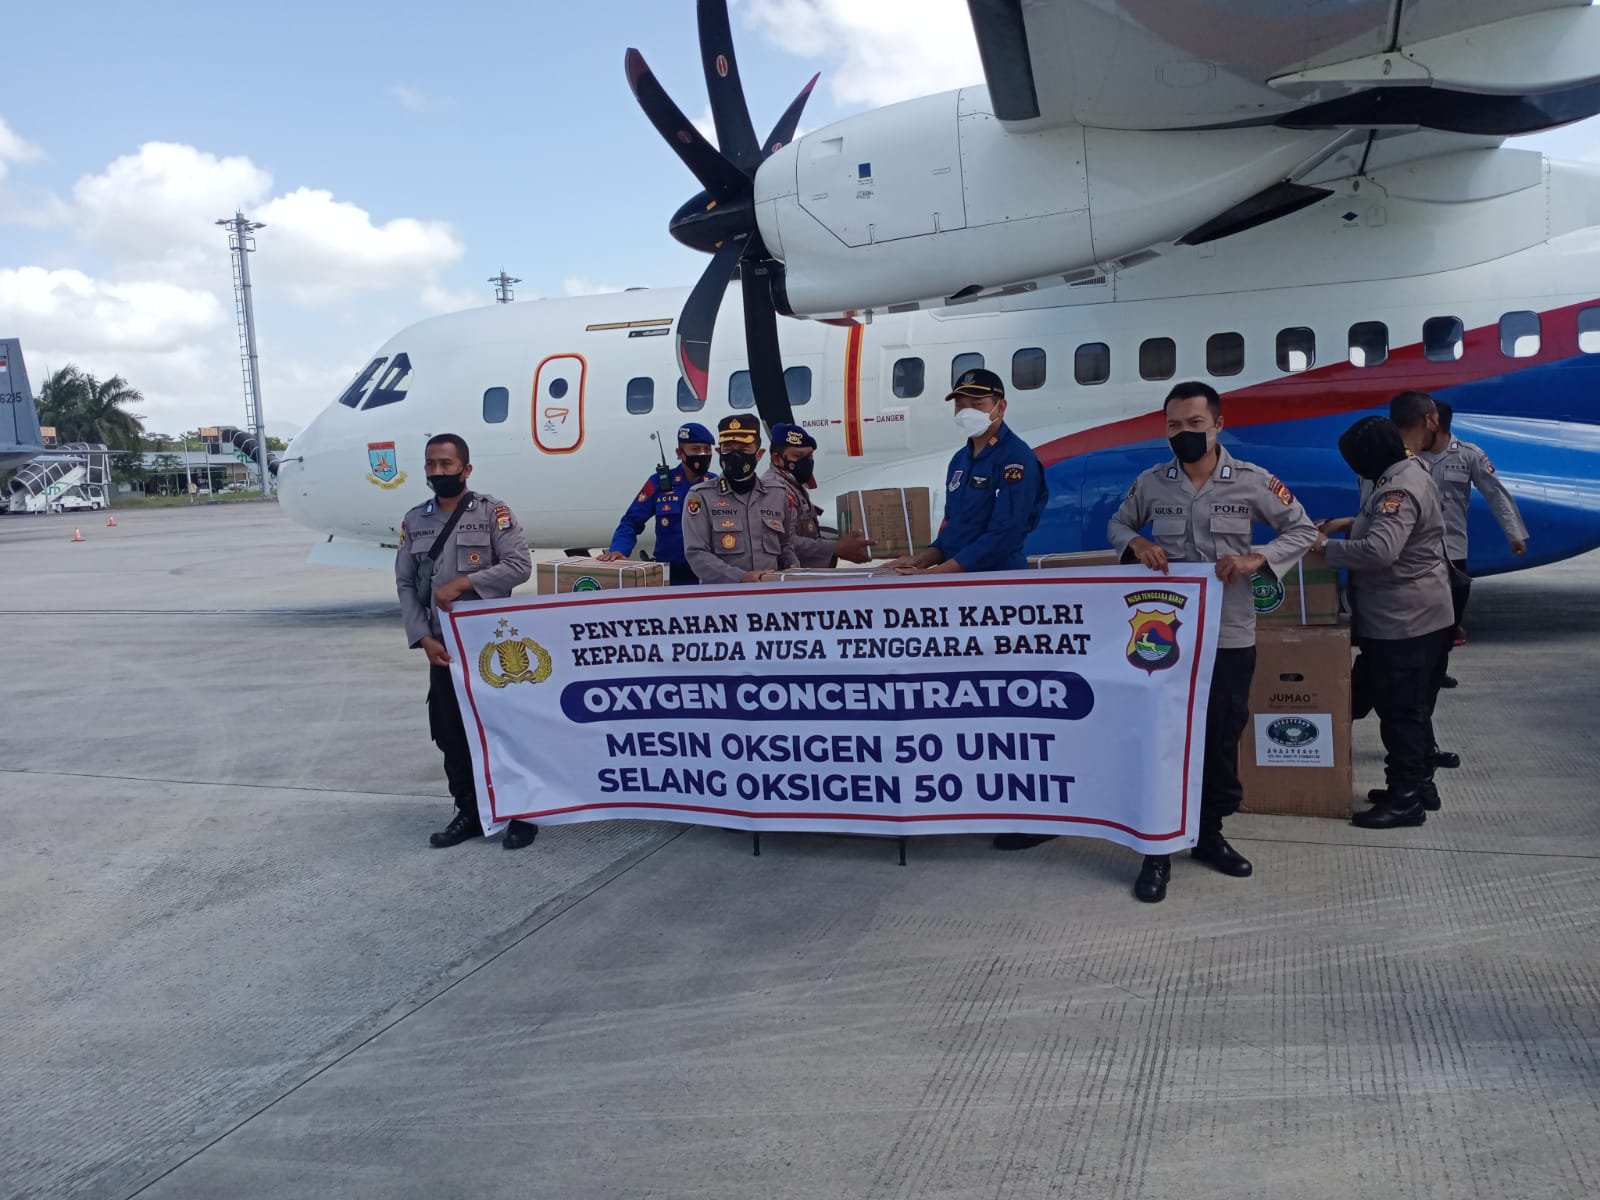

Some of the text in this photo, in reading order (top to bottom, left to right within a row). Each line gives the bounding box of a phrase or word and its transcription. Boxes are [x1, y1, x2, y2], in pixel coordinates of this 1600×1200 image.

[803, 419, 829, 428] DANGER
[876, 414, 905, 423] DANGER
[711, 508, 738, 516] BENNY
[1214, 504, 1249, 514] POLRI
[570, 604, 1084, 641] PENYERAHAN BANTUAN DARI KAPOLRI
[572, 633, 1091, 667] KEPADA POLDA NUSA TENGGARA BARAT
[583, 678, 1069, 713] OXYGEN CONCENTRATOR
[605, 731, 1056, 764] MESIN OKSIGEN 50 UNIT
[598, 767, 1076, 804] SELANG OKSIGEN 50 UNIT
